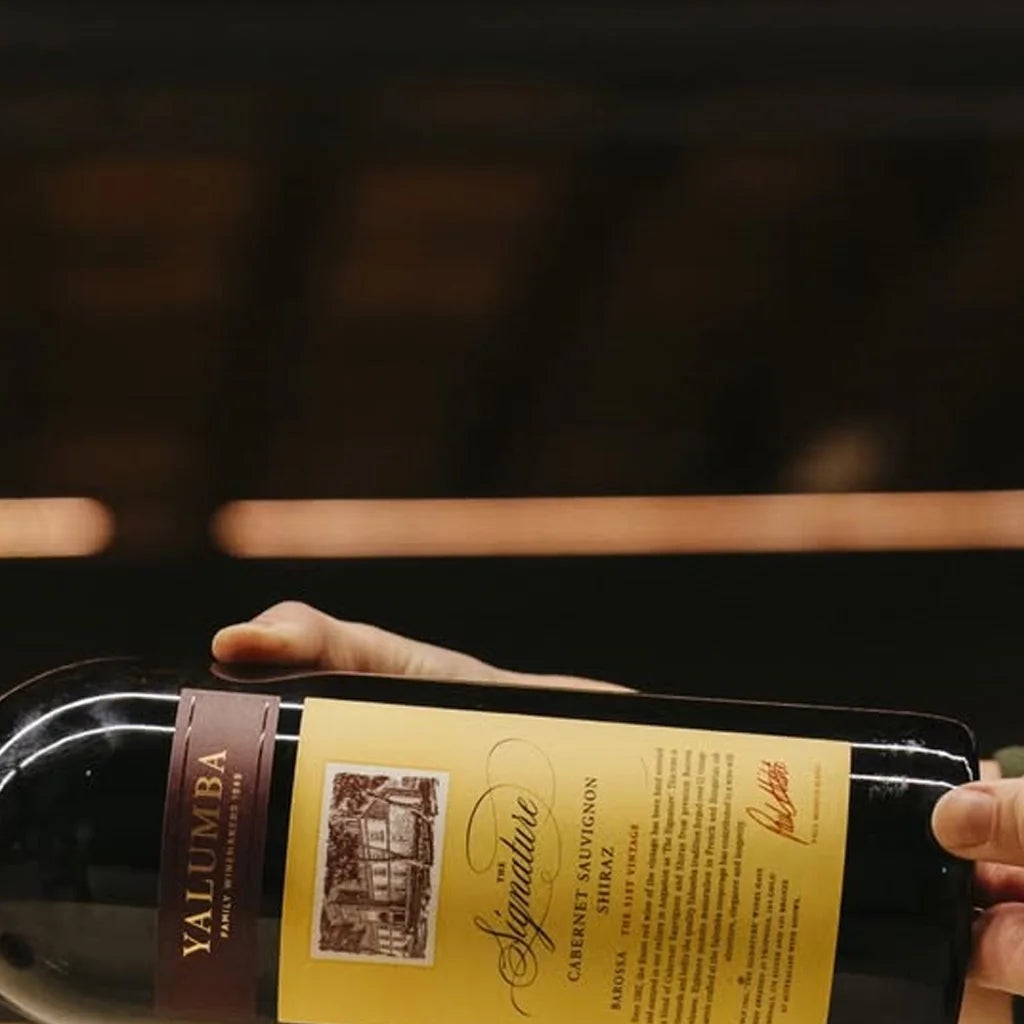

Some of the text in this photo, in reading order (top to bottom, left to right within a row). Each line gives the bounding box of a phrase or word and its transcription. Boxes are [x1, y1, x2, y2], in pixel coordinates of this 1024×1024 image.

[181, 748, 225, 957] YALUMBA
[224, 804, 238, 888] WINEMAKERS
[496, 862, 505, 882] THE
[567, 776, 597, 981] CABERNET SAUVIGNON
[596, 845, 614, 914] SHIRAZ
[621, 913, 631, 935] THE
[626, 824, 638, 874] VINTAGE
[220, 895, 231, 937] FAMILY
[472, 793, 556, 988] Signature
[611, 950, 626, 1009] BAROSSA
